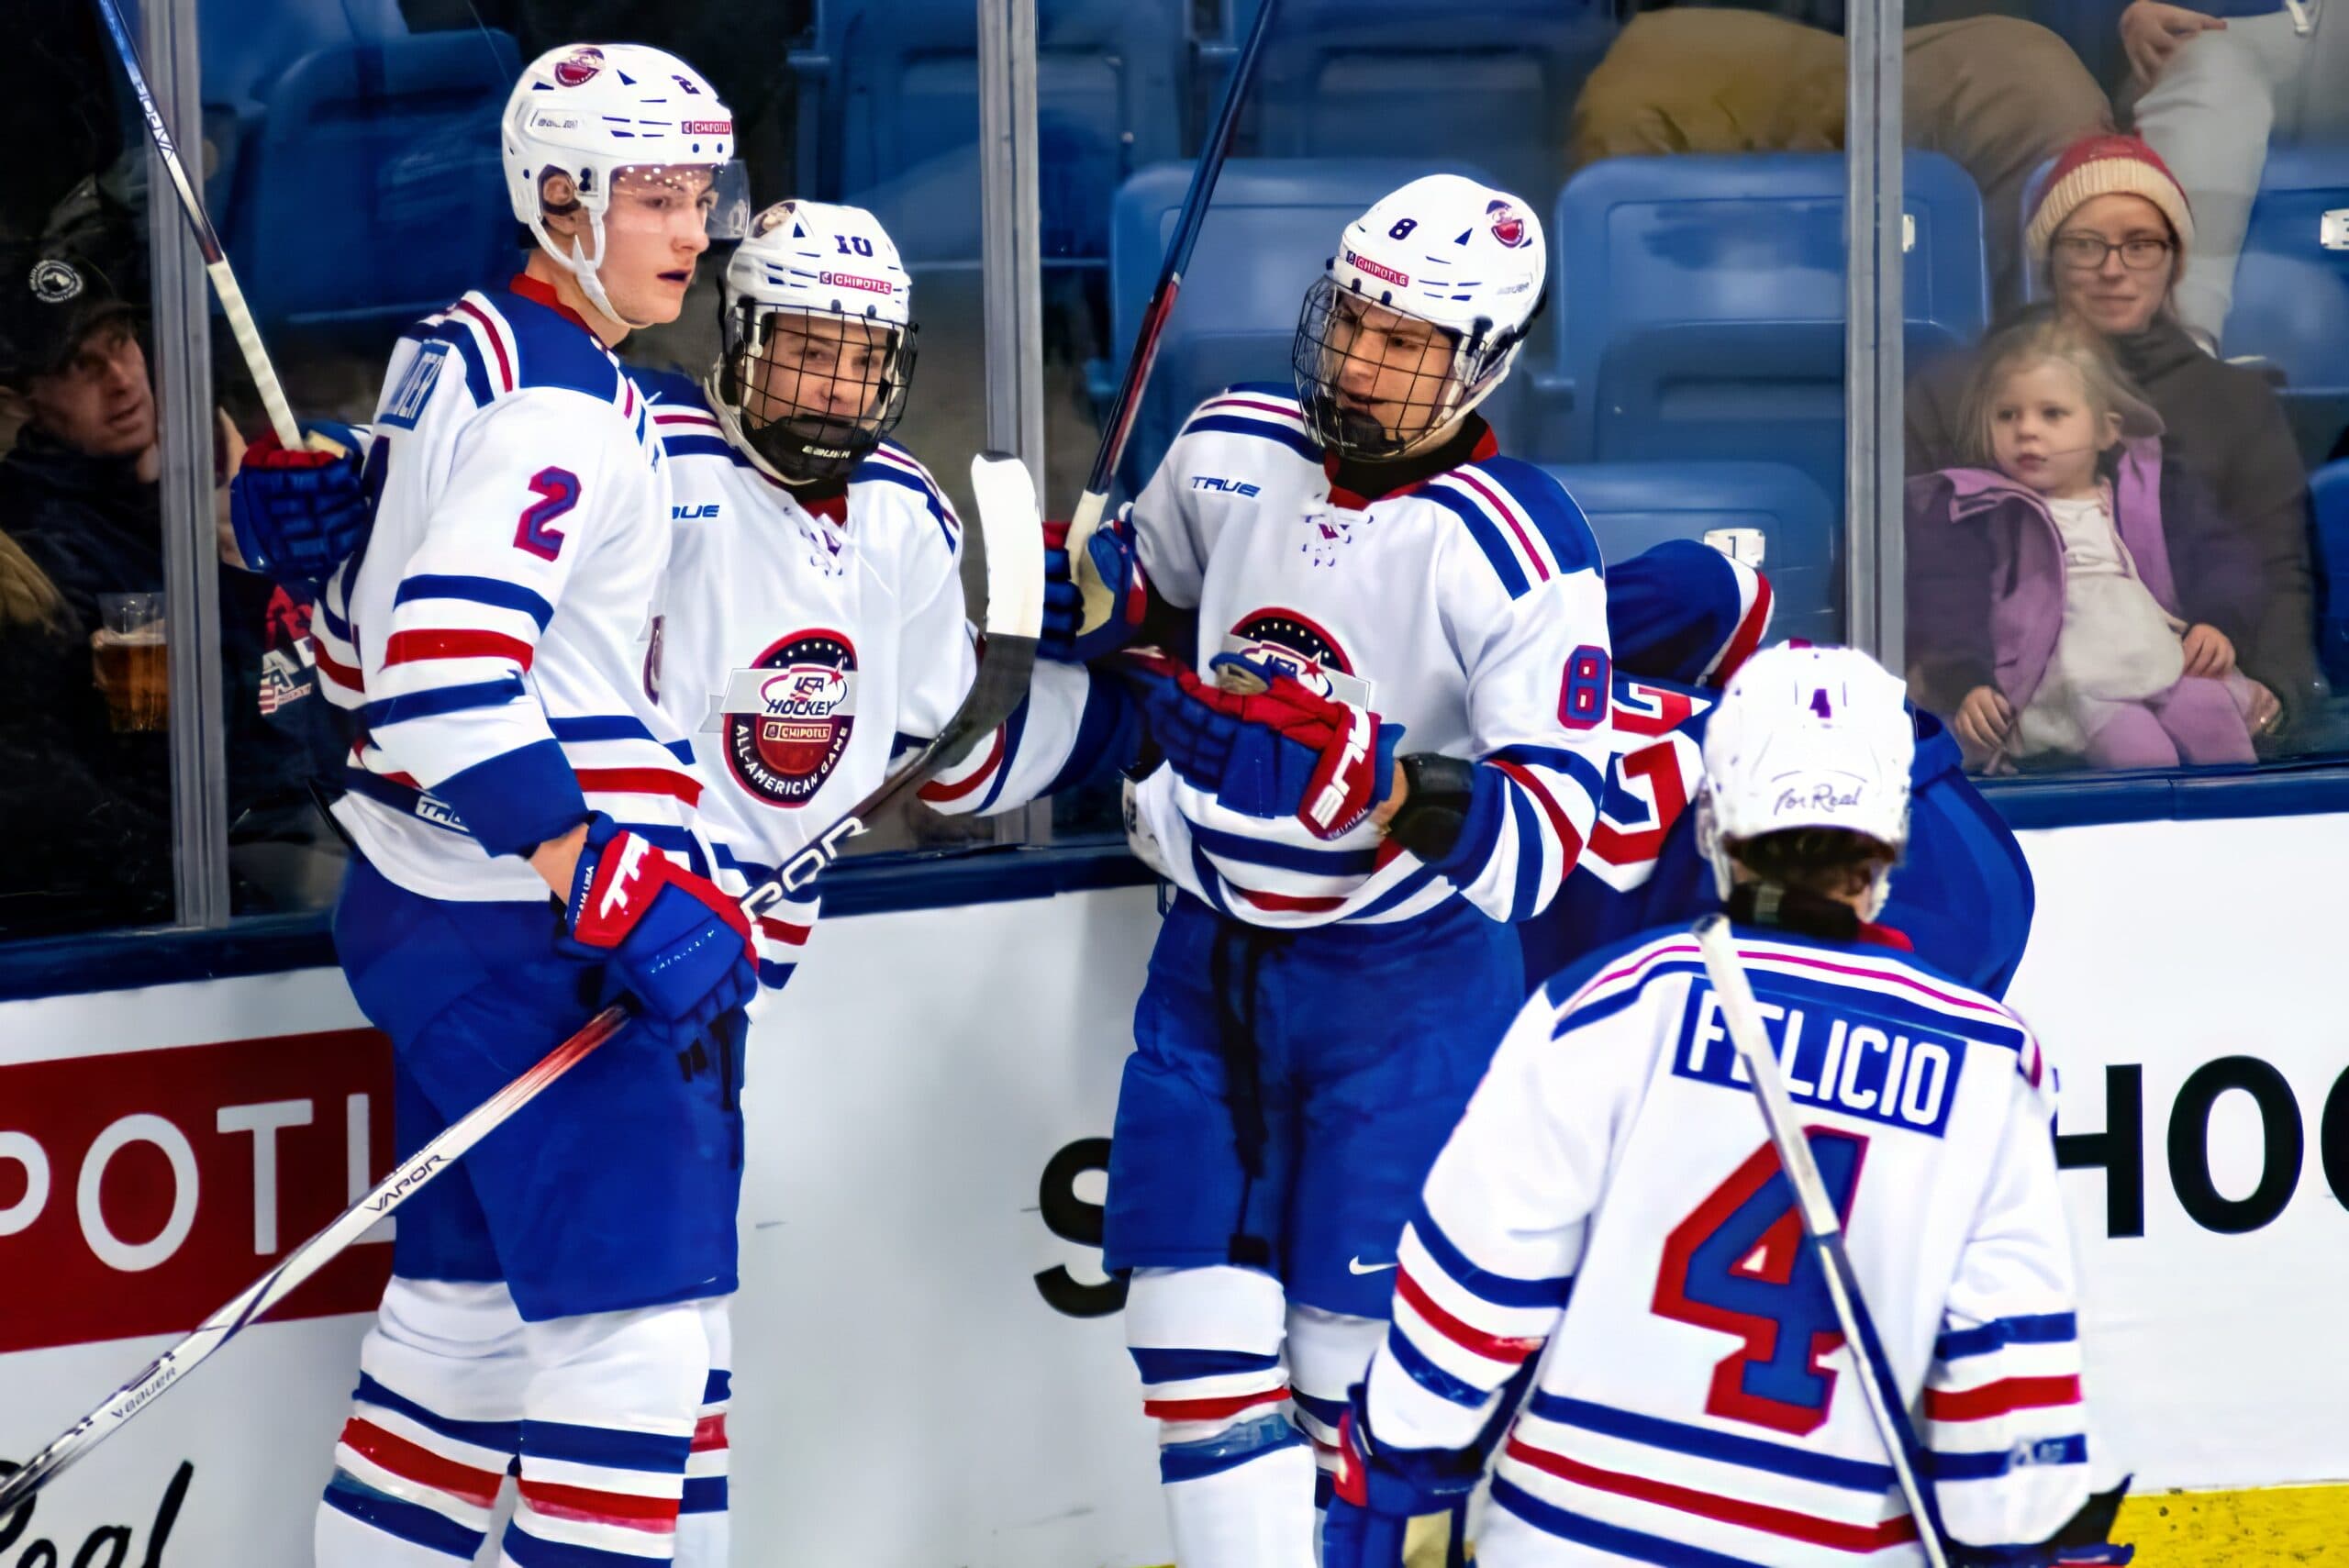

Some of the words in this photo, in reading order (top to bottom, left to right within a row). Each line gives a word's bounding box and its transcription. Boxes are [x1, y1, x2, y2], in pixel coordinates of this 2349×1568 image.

[1388, 217, 1419, 240] 8
[834, 235, 874, 257] 10
[834, 275, 892, 295] CHIPOTLE
[1357, 258, 1408, 286] CHIPOTLE
[1192, 476, 1261, 497] TRUE
[513, 465, 582, 562] 2
[792, 676, 825, 701] USA
[1557, 644, 1612, 730] 8
[765, 699, 837, 716] HOCKEY
[1809, 688, 1832, 718] 4
[781, 727, 829, 740] CHIPOTLE
[735, 724, 818, 796] ALL-AMERICAN
[2052, 1054, 2349, 1239] HO
[364, 1154, 456, 1211] VAPOR
[1650, 1124, 1870, 1437] 4
